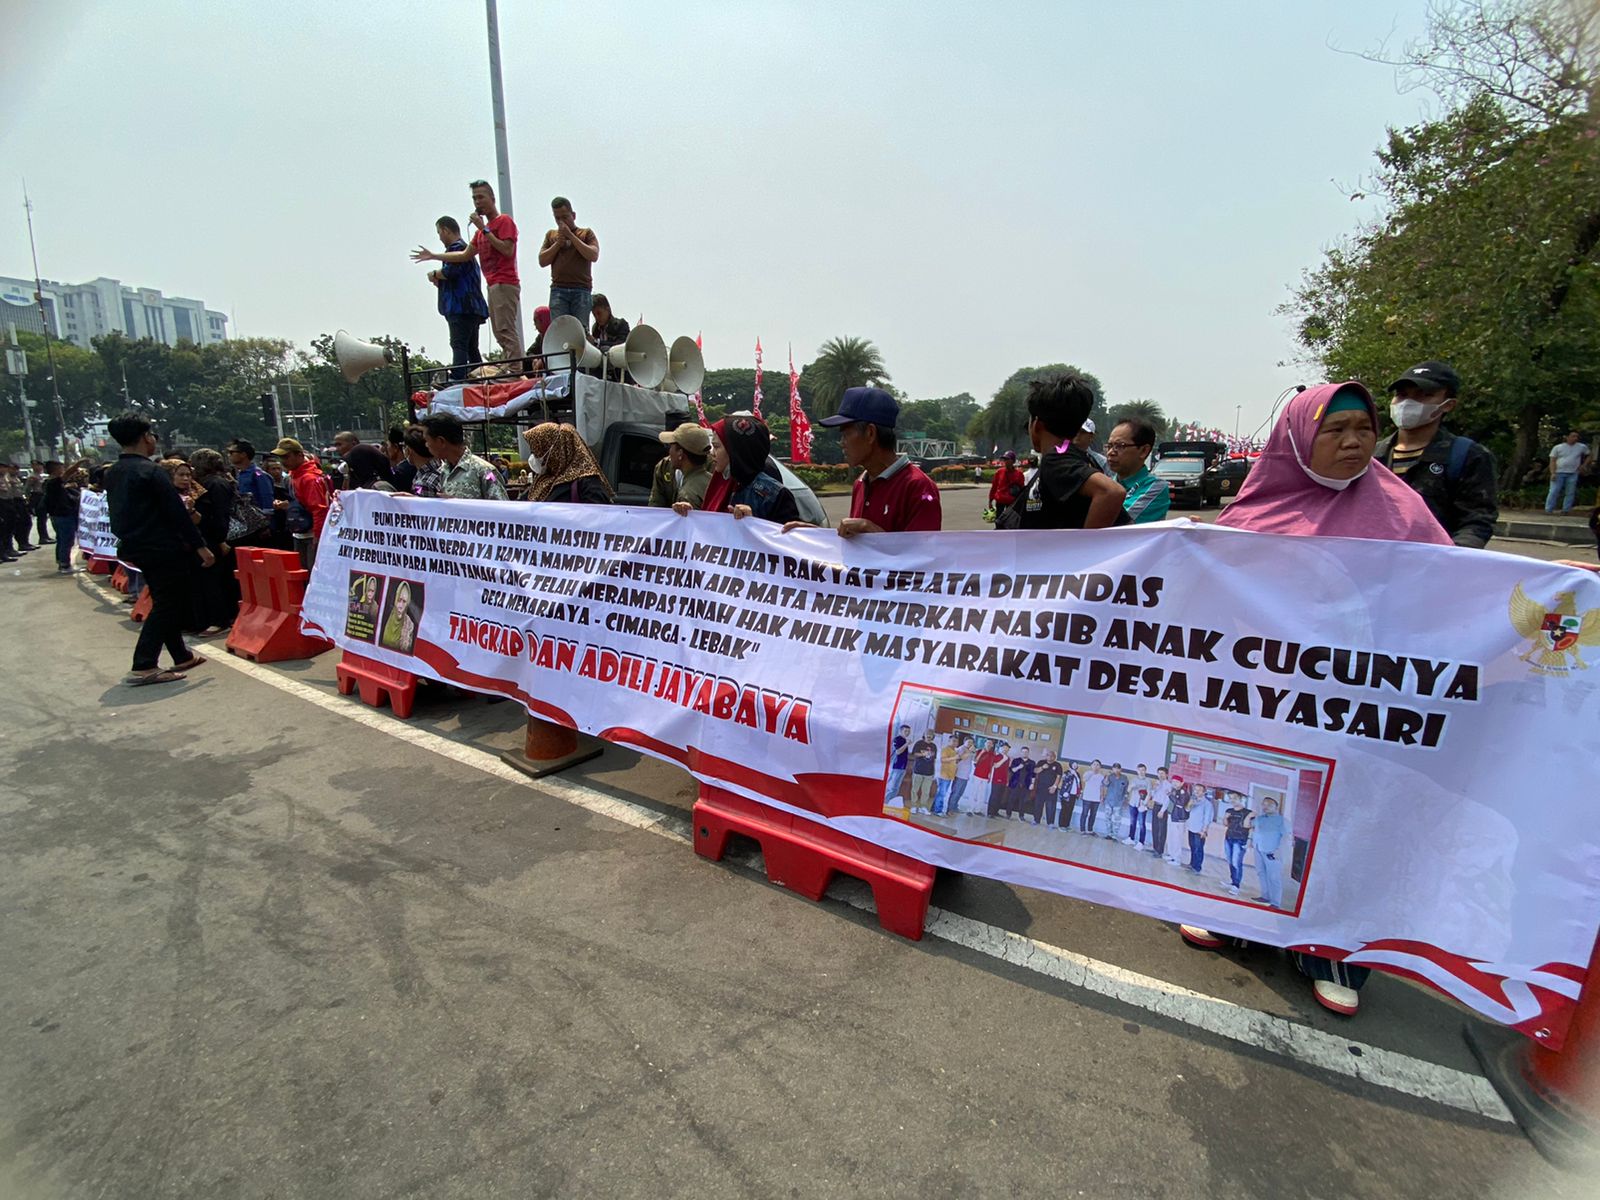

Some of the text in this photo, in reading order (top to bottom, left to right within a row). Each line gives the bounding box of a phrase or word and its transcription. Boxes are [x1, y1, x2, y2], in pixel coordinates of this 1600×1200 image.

[364, 530, 385, 546] NASIB
[387, 532, 408, 549] YANG
[410, 535, 439, 553] TIDAK
[439, 539, 493, 560] BERDAYA
[495, 545, 538, 567] HANYA
[540, 551, 596, 574] MAMPU
[596, 557, 705, 589] MENETESKAN
[704, 573, 745, 599] AIR
[747, 580, 808, 611] MATA
[811, 591, 988, 633] MEMIKIRKAN
[990, 609, 1098, 645] NASIB
[1103, 618, 1224, 663] ANAK
[1232, 636, 1480, 702] CUCUNYA
[395, 513, 436, 531] PERTIWI
[437, 516, 496, 538] MENANGIS
[498, 523, 547, 544] KARENA
[550, 528, 600, 550] MASIH
[604, 533, 688, 563] TERJAJAH,
[690, 542, 780, 575] MELIHAT
[783, 555, 880, 589] RAKYAT
[883, 570, 981, 598] JELATA
[988, 573, 1164, 607] DITINDAS
[481, 588, 506, 609] DESA
[506, 594, 590, 625] MEKARJAYA
[606, 612, 679, 645] CIMARGA
[353, 547, 401, 567] PERBUATAN
[403, 554, 427, 572] PARA
[429, 558, 460, 578] MAFIA
[460, 563, 497, 582] TANAH
[500, 569, 532, 588] YANG
[532, 575, 579, 597] TELAH
[578, 580, 677, 614] MERAMPAS
[679, 595, 736, 625] TANAH
[736, 608, 790, 638] HAK
[788, 619, 863, 652] MILIK
[863, 631, 1081, 686] MASYARAKAT
[1088, 659, 1189, 704] DESA
[1199, 676, 1447, 747] JAYASARI
[449, 611, 812, 745] TANGKAP DAN ADILI JAYABAYA
